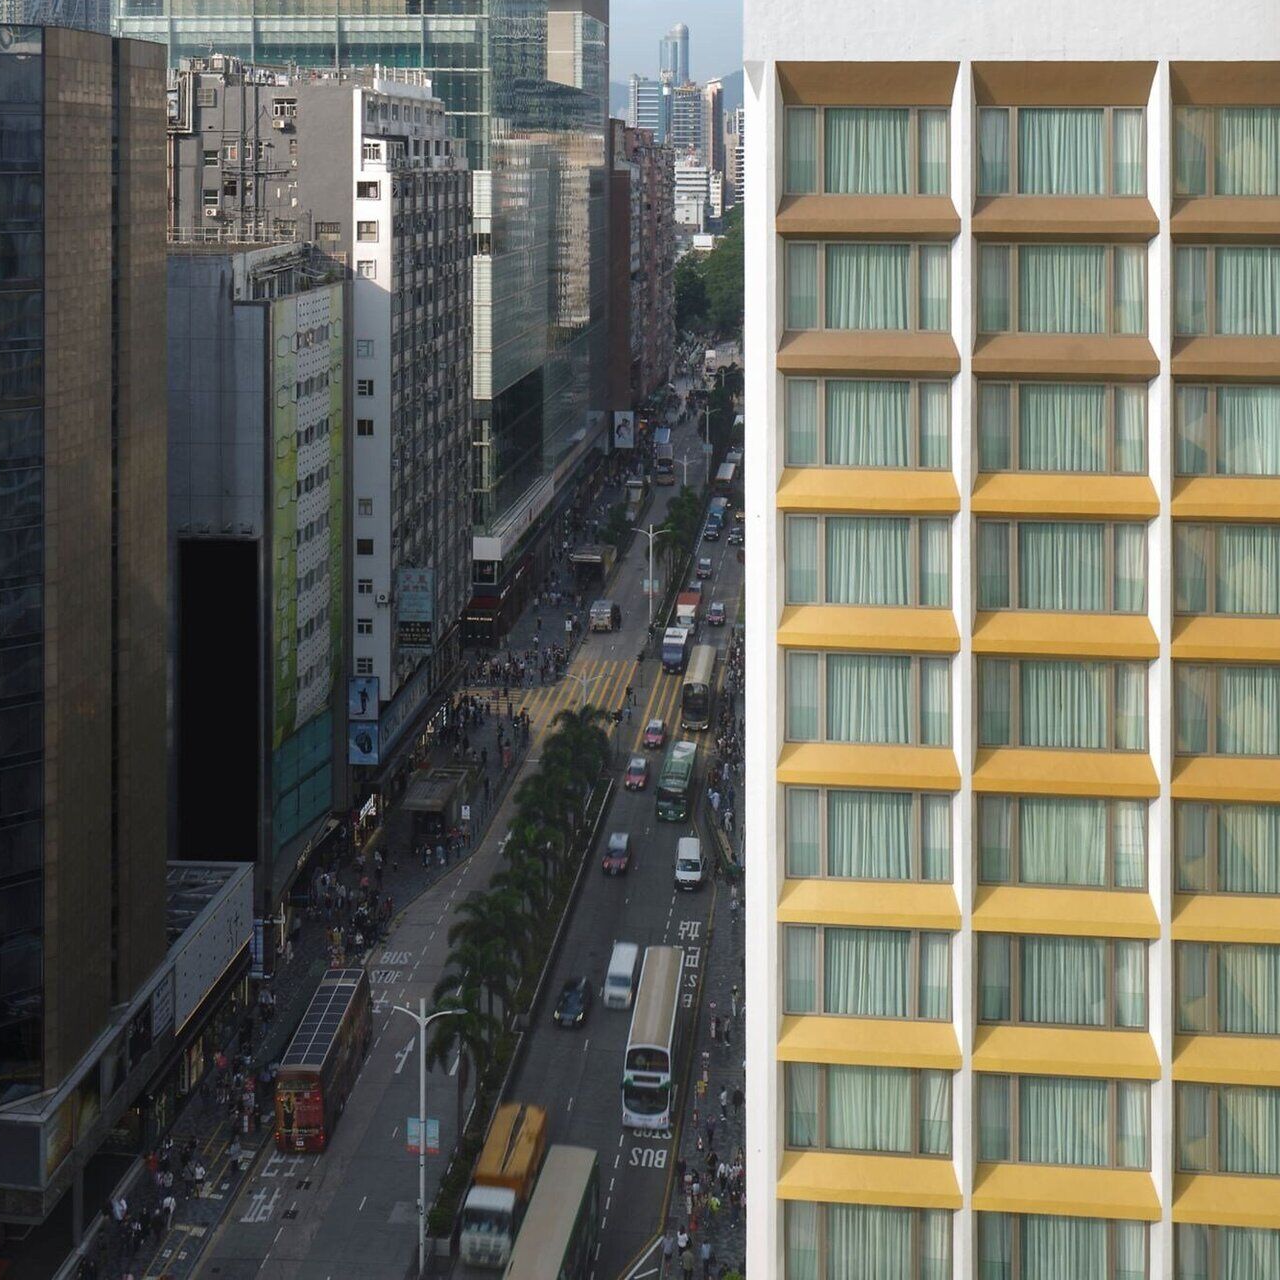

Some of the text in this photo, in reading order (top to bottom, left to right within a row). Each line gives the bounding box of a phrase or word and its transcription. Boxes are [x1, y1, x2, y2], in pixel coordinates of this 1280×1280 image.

[678, 920, 702, 941] 站
[380, 951, 412, 965] BUS
[629, 1147, 668, 1169] BUS
[239, 1186, 281, 1223] 站
